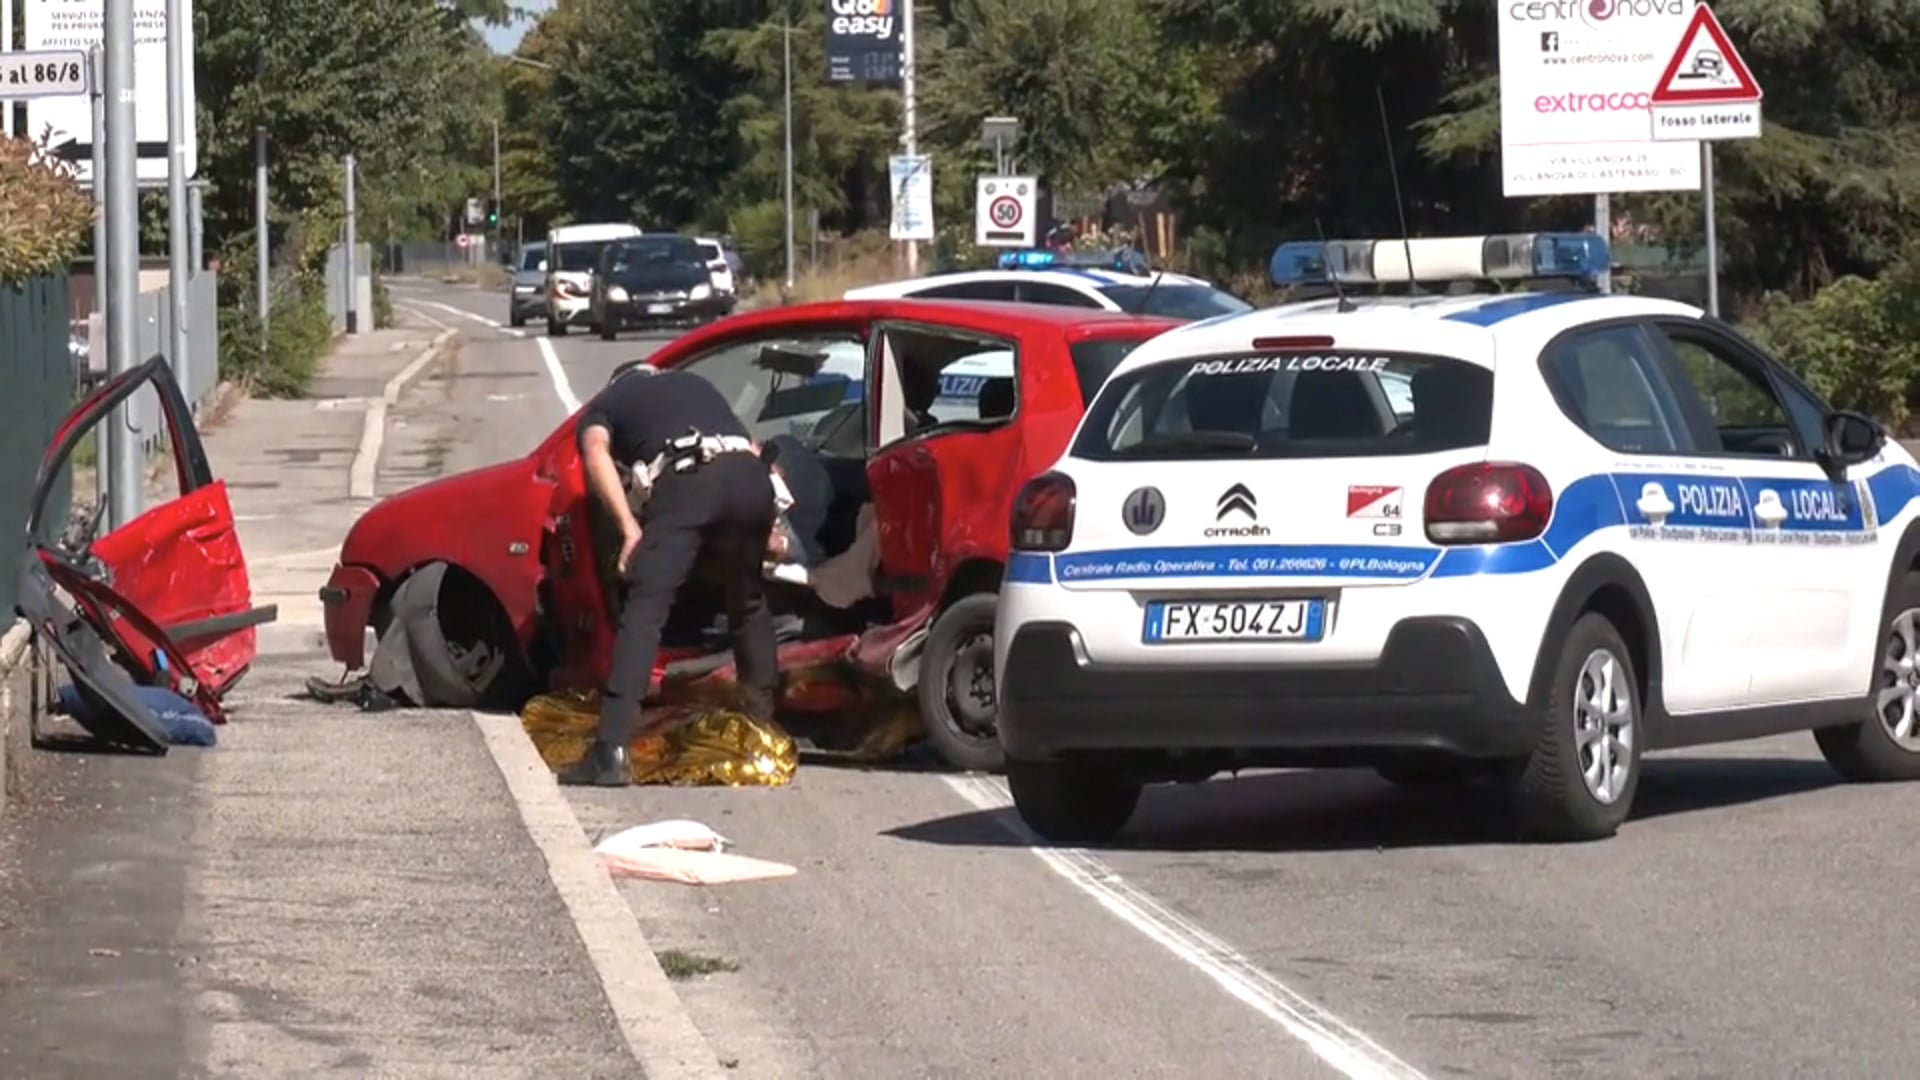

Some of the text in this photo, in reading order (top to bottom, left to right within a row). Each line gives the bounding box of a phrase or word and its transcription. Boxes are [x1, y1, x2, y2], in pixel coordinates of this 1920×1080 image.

[832, 16, 893, 39] easy
[41, 37, 81, 47] AFFITTO
[9, 64, 28, 84] al
[35, 62, 79, 83] 86/8
[1661, 113, 1752, 127] fosso laterale
[997, 203, 1016, 220] 50
[1187, 355, 1390, 377] POLIZIA LOCALE
[1382, 503, 1400, 518] 64
[1678, 484, 1848, 522] POLIZIA LOCALE
[1372, 523, 1402, 536] C3
[1063, 562, 1114, 577] Centrale
[1115, 560, 1150, 574] Radio
[1153, 559, 1215, 575] Operativa
[1339, 556, 1425, 573] @PLBologna
